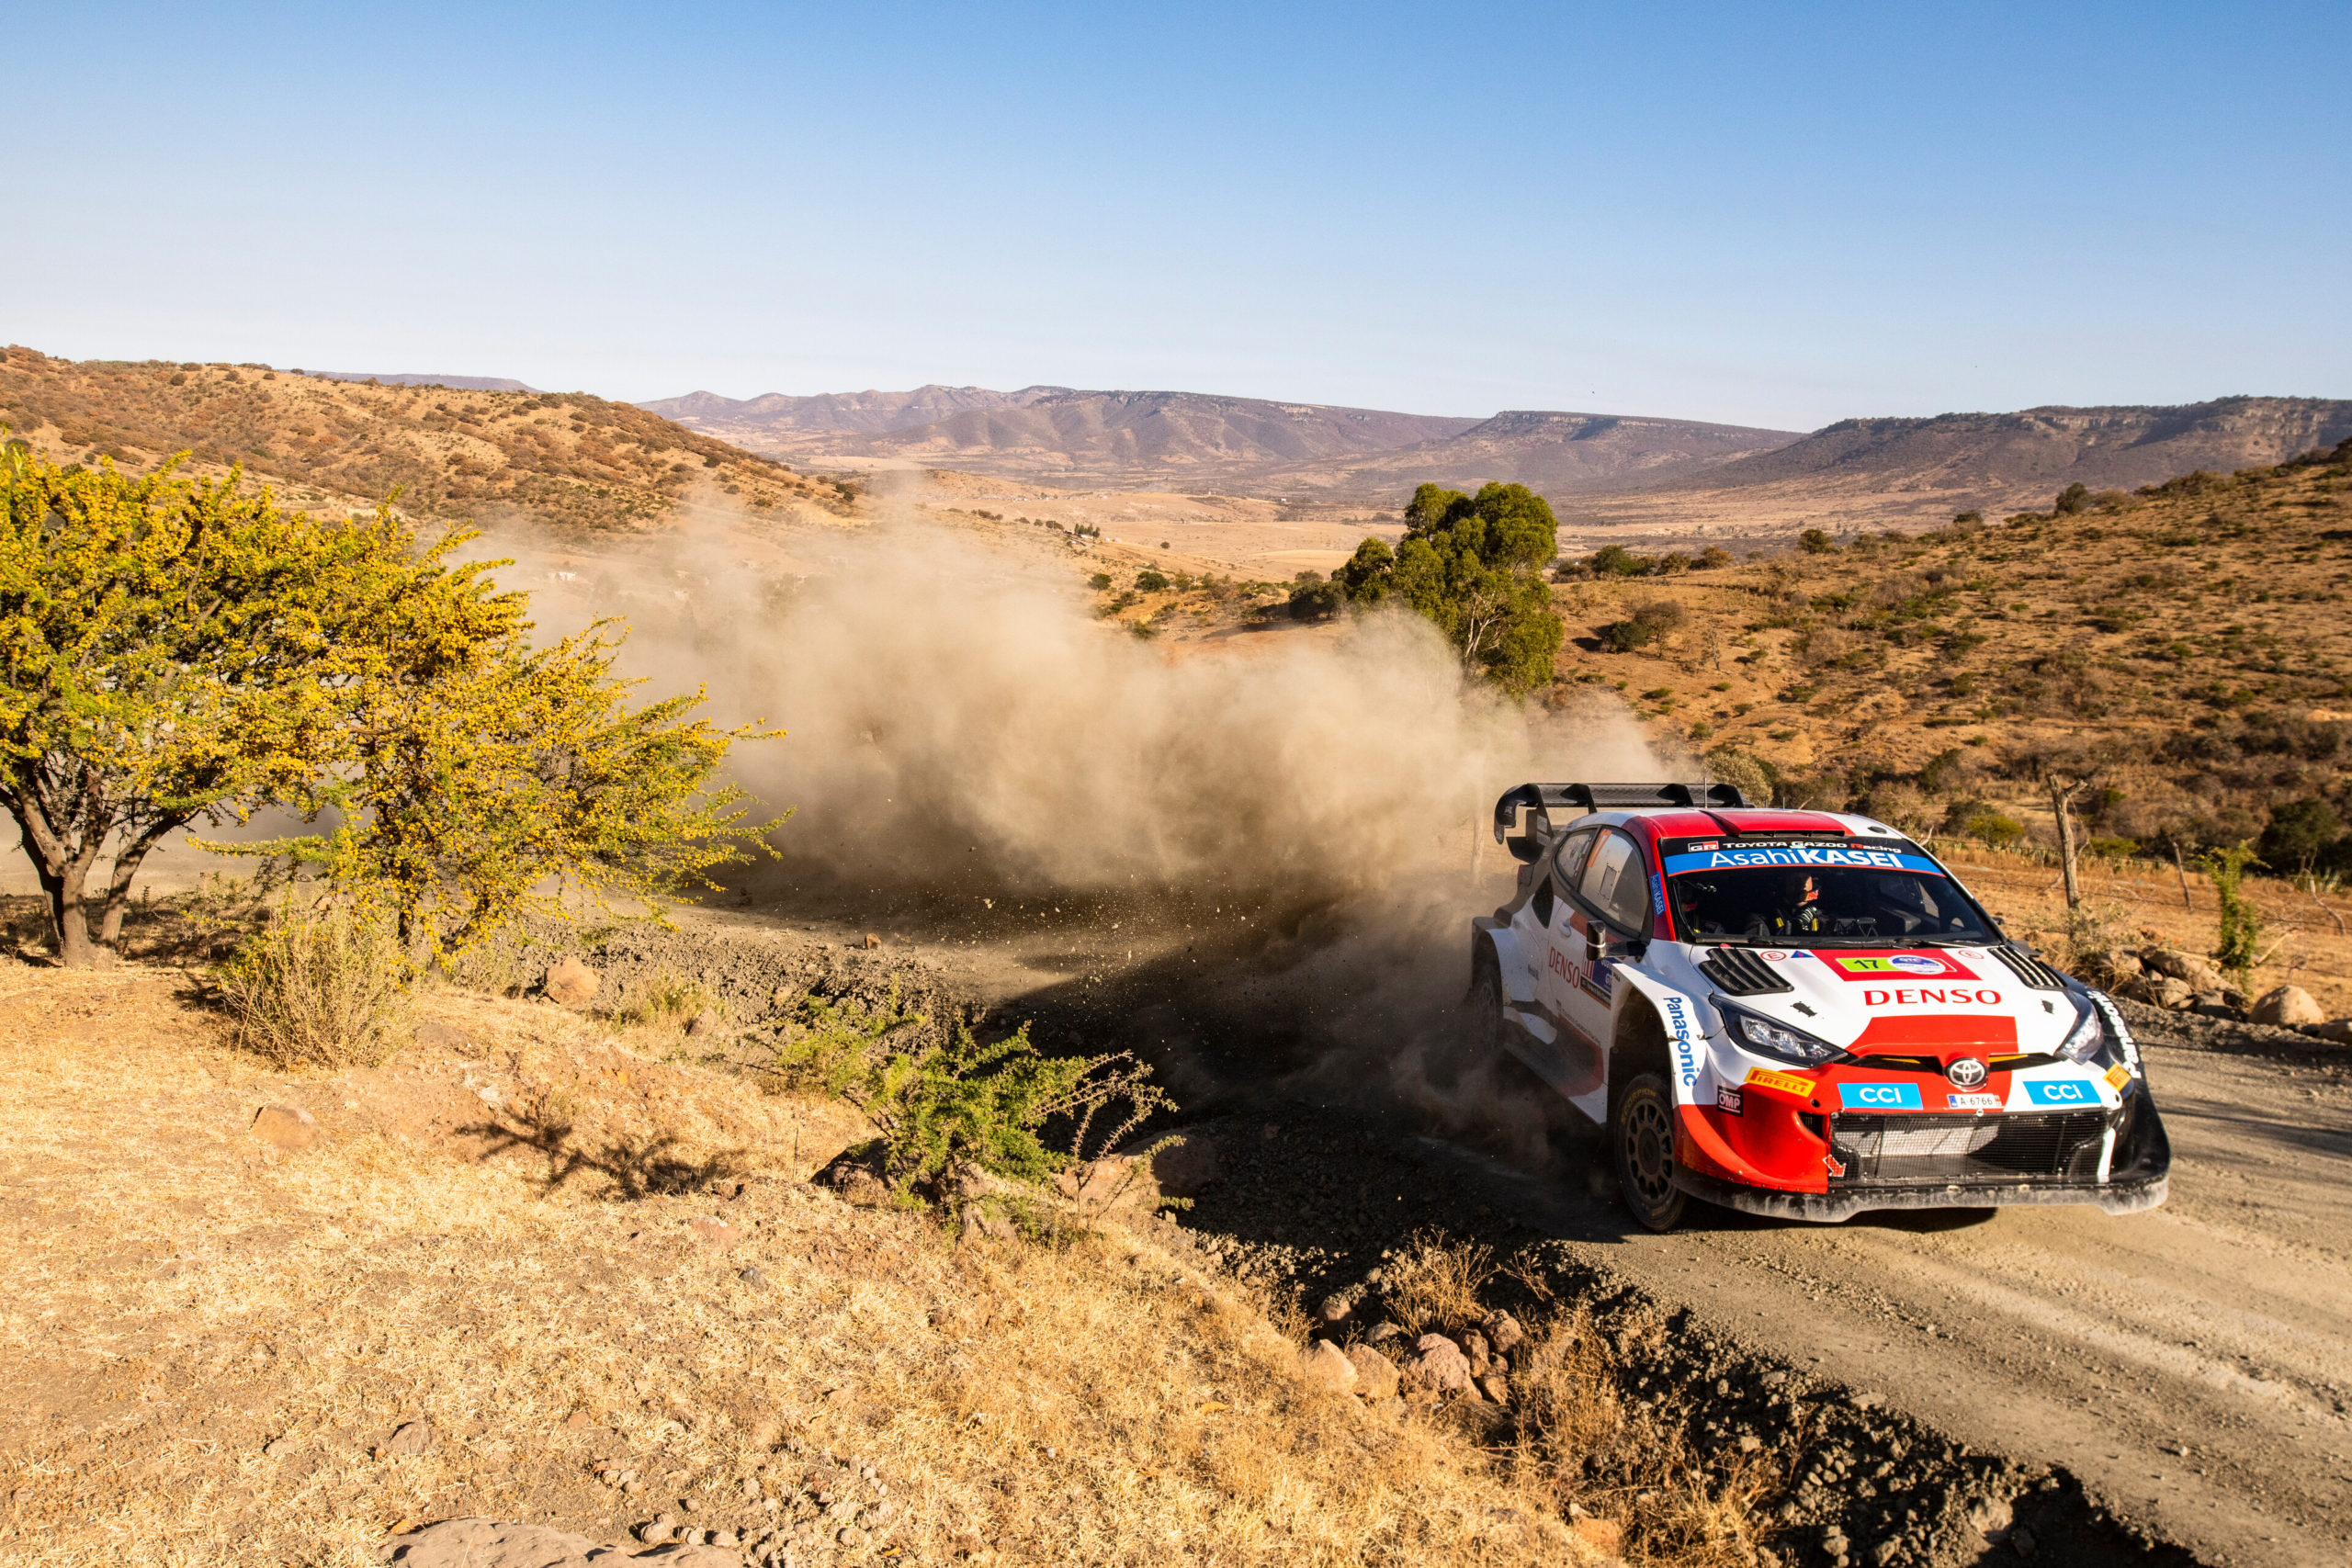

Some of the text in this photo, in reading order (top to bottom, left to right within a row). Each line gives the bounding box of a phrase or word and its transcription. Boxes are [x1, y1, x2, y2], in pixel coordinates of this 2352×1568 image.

[1690, 841, 1718, 851] GR
[1850, 842, 1902, 853] Racing
[1710, 849, 1905, 868] AsahiKASEI
[1549, 946, 1580, 989] DENSO
[1854, 960, 1879, 969] 17
[1863, 988, 2002, 1006] DENSO
[1663, 997, 1701, 1087] Panasonic
[1750, 1069, 1810, 1093] PIRELLI
[1719, 1093, 1741, 1110] OMP
